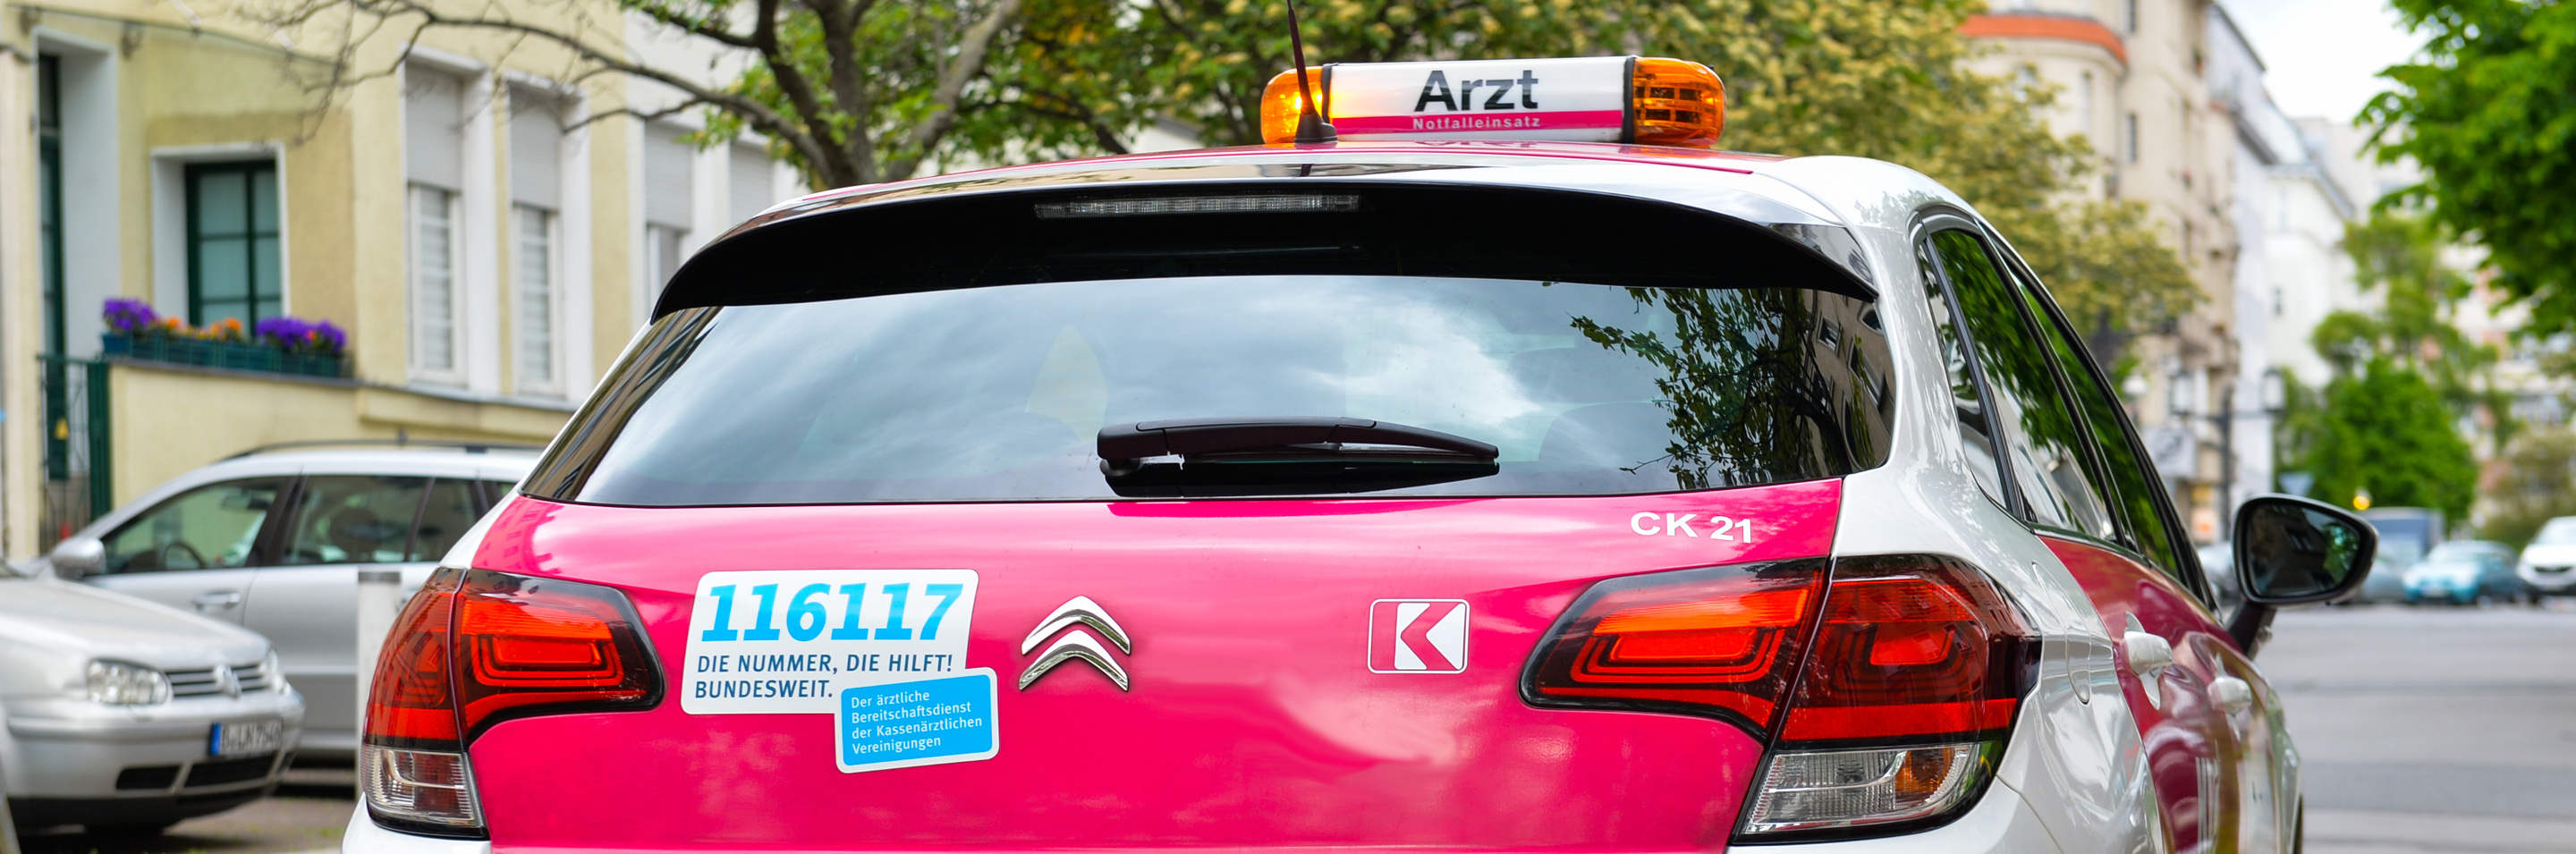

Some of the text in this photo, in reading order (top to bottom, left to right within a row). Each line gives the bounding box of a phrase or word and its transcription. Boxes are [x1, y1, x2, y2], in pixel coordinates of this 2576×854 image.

[1414, 70, 1538, 112] Arzt
[1413, 116, 1540, 130] Notfalleinsatz
[1631, 512, 1751, 544] CK 21
[701, 582, 963, 642] 116117
[698, 654, 953, 674] DIE NUMMER, DIE HILFT!
[695, 680, 833, 698] BUNDESWEIT.
[852, 690, 929, 708] Der ärztliche
[852, 701, 971, 723] Bereitschaftsdienst
[852, 716, 982, 739] der Kassenärztlichen
[852, 737, 941, 754] Vereinigungen
